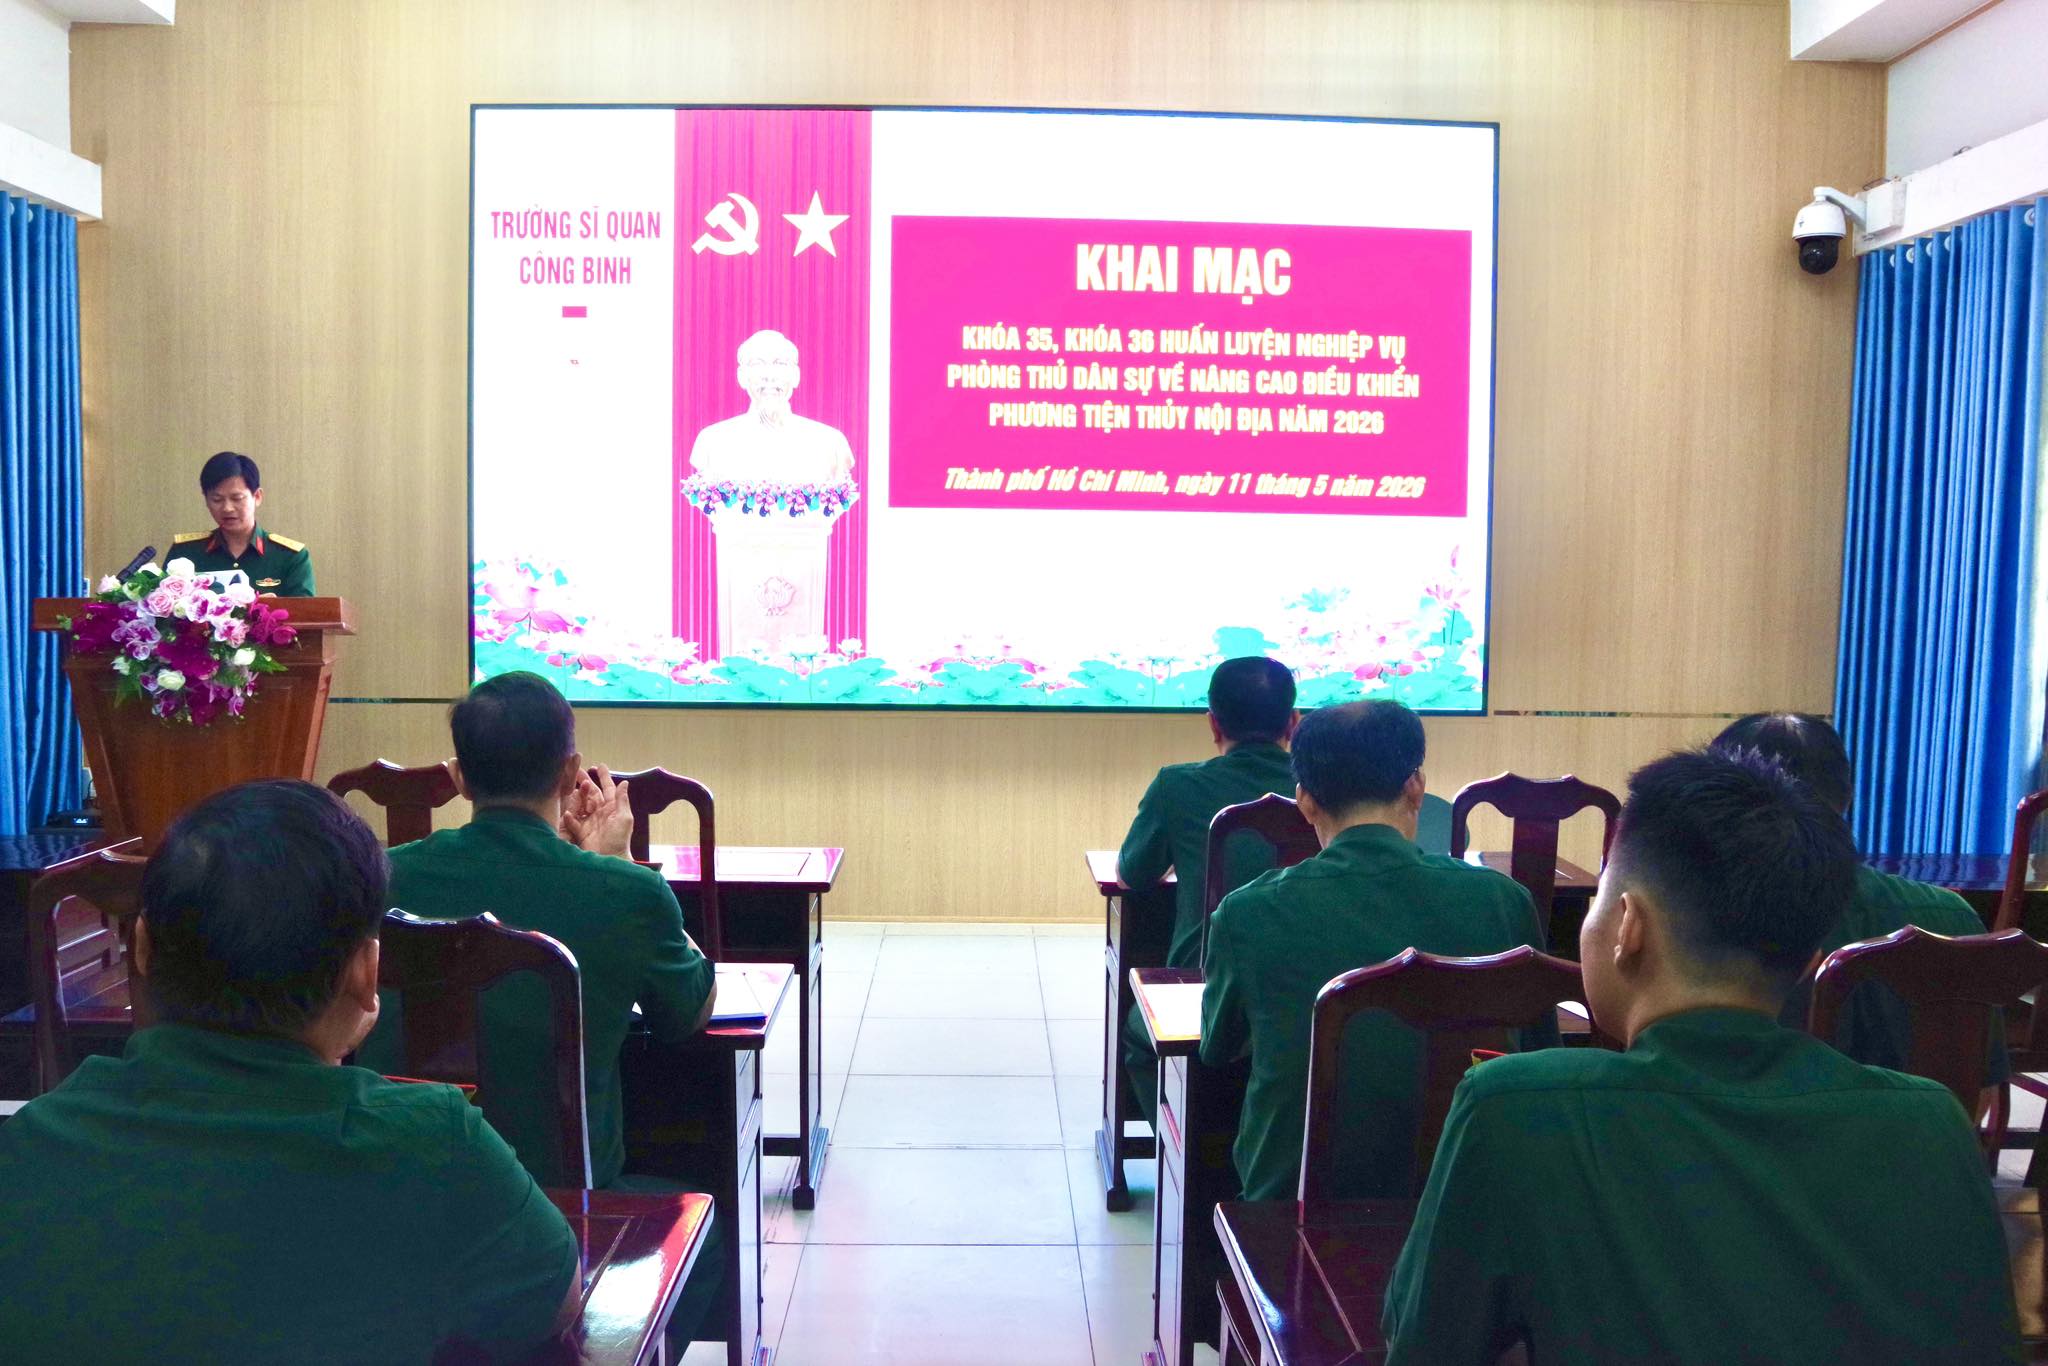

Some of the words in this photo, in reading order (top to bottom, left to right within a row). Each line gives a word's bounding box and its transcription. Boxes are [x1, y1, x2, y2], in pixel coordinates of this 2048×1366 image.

[491, 204, 571, 239] TRƯỜNG
[607, 211, 661, 242] QUAN
[519, 250, 575, 285] CÔNG
[583, 256, 632, 285] BINH
[1076, 243, 1179, 293] KHAI
[1193, 246, 1292, 305] MẠC
[962, 322, 1021, 350] KHÓA
[1026, 327, 1059, 354] 35,
[1064, 324, 1123, 353] KHÓA
[1128, 329, 1155, 353] 36
[1160, 323, 1219, 354] HUẤN
[1224, 328, 1291, 361] LUYỆN
[1296, 330, 1373, 363] NGHIỆP
[1378, 336, 1406, 364] VỤ
[947, 359, 1021, 389] PHÒNG
[1026, 358, 1068, 390] THỦ
[1073, 362, 1118, 390] DÂN
[1123, 366, 1155, 397] SỰ
[1190, 364, 1250, 393] NÂNG
[1255, 370, 1298, 394] CAO
[989, 401, 1077, 428] PHƯƠNG
[1082, 400, 1131, 434] TIỆN
[1135, 398, 1189, 430] THỦY
[1194, 402, 1232, 435] NỘI
[1236, 407, 1273, 436] ĐỊA
[1279, 403, 1329, 433] NĂM
[1333, 409, 1385, 435] 2026
[944, 467, 1005, 490] Thành
[1005, 465, 1051, 493] phố
[1078, 469, 1115, 492] Chí
[1114, 470, 1171, 495] Minh,
[1174, 471, 1226, 497] ngày
[1228, 472, 1253, 495] 11
[1254, 472, 1312, 498] tháng
[1312, 474, 1330, 497] 5
[1329, 474, 1375, 498] năm
[1374, 476, 1428, 499] 2026
